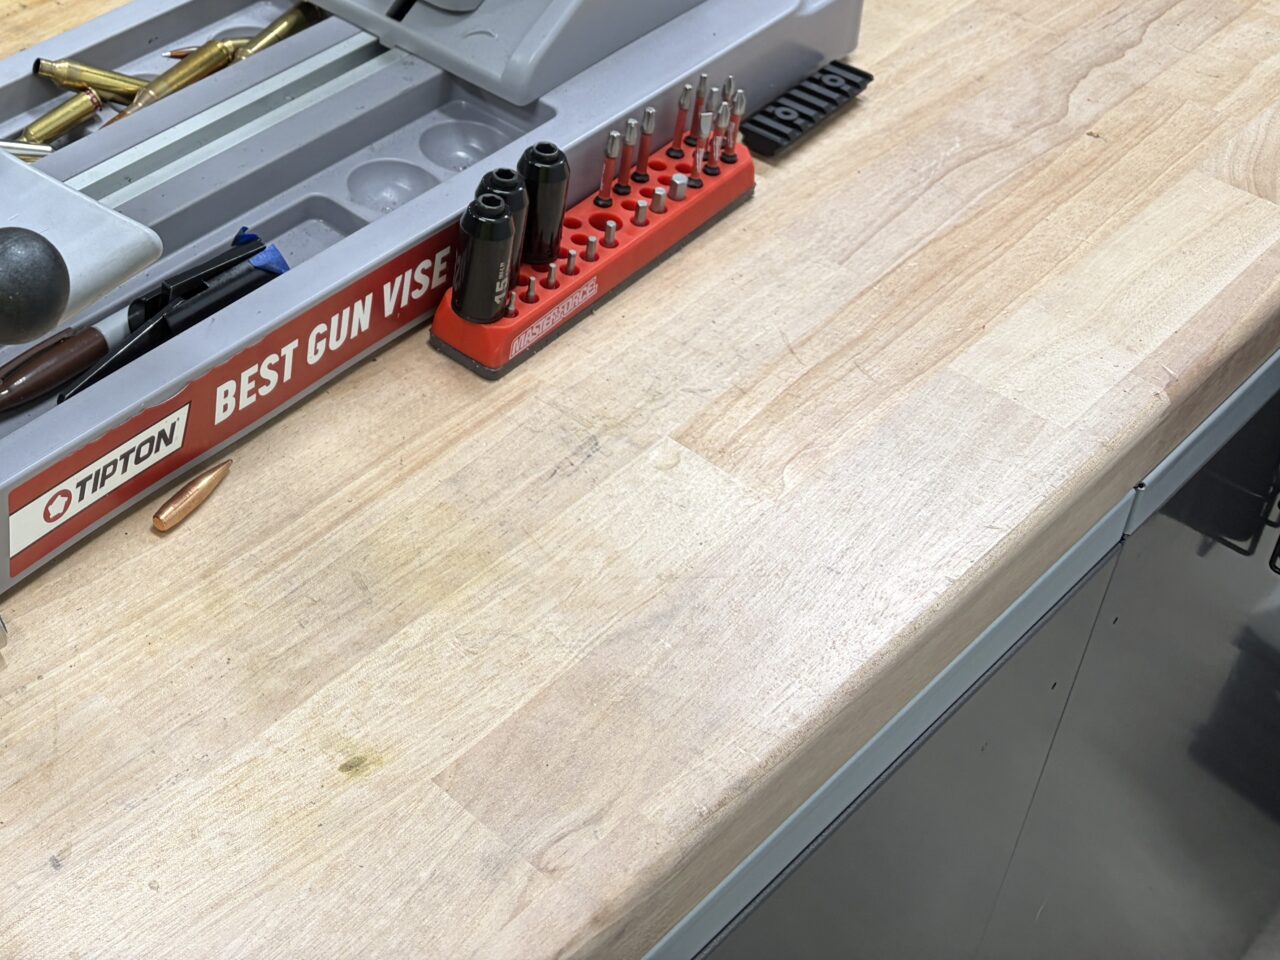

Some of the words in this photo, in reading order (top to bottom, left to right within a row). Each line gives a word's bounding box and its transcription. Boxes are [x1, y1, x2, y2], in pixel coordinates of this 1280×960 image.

[214, 339, 299, 426] BEST
[306, 292, 374, 366] GUN
[382, 246, 451, 319] VISE
[510, 276, 598, 359] MASTERFORCE
[75, 420, 178, 505] TIPTON
